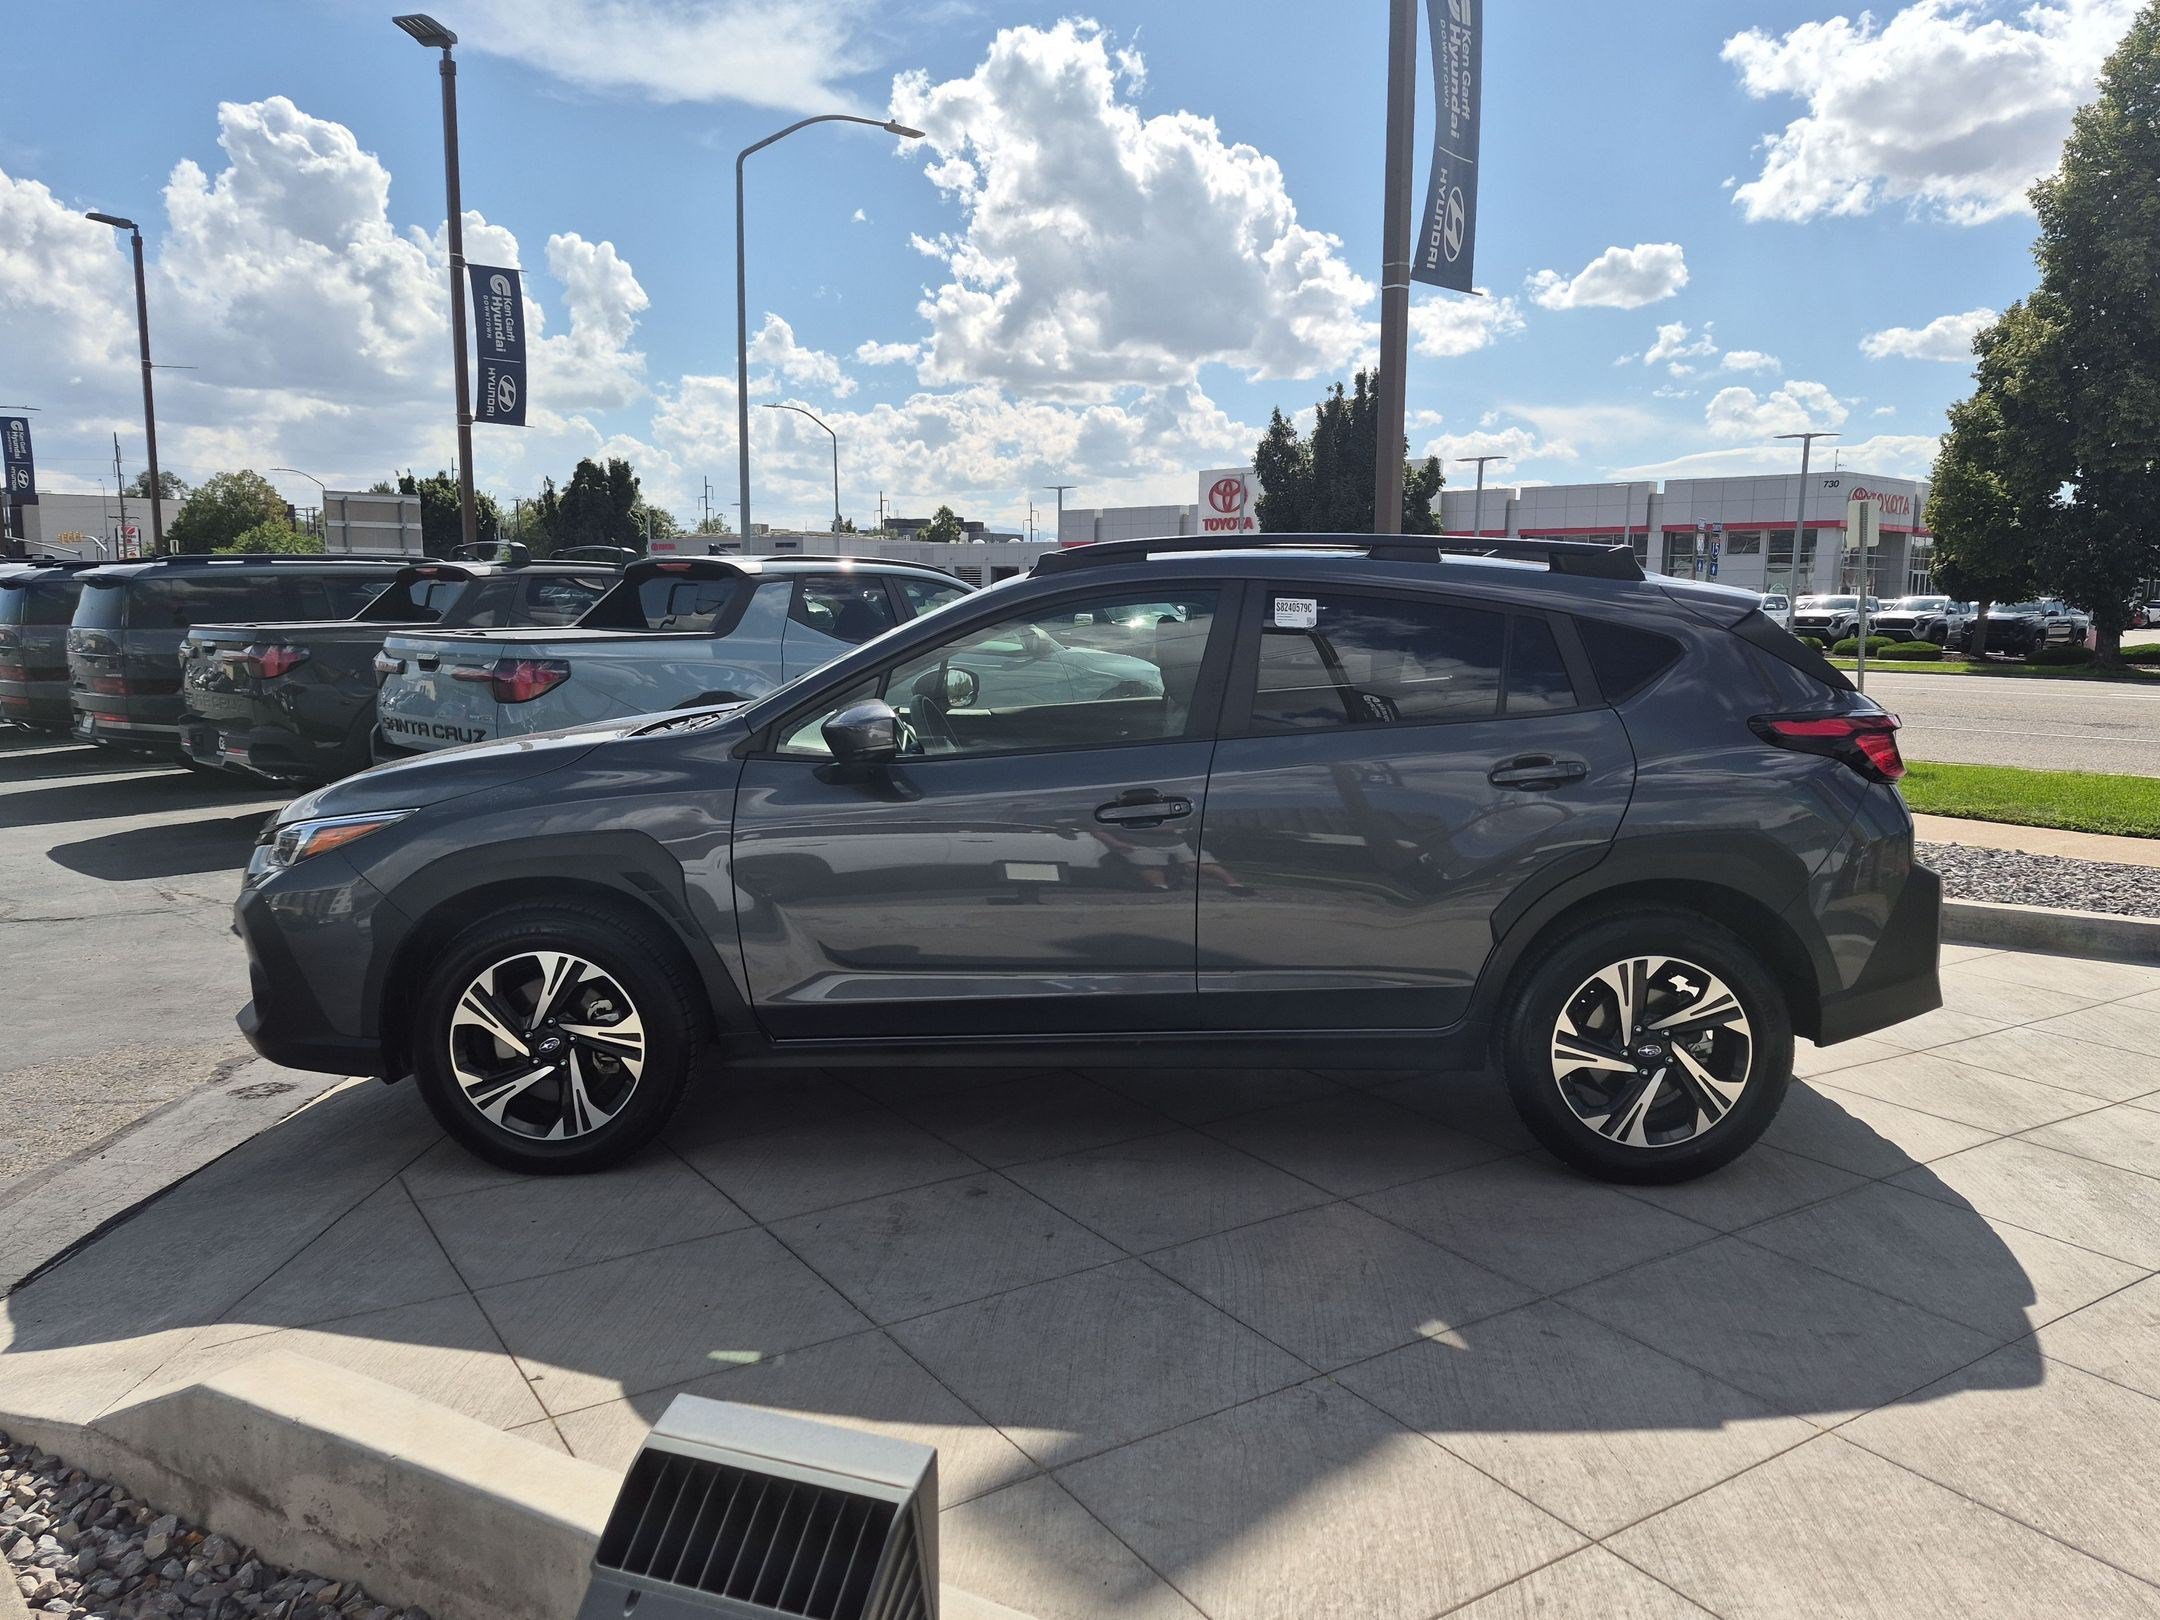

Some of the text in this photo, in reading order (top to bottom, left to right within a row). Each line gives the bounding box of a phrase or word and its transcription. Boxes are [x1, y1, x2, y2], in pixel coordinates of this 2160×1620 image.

[1440, 19, 1449, 108] DOWNTOWN
[1448, 23, 1461, 139] Hyundai
[1461, 28, 1471, 120] Ken Garff
[1426, 167, 1448, 269] HYUNDAI
[483, 294, 492, 339] DOWNTOWN
[491, 296, 506, 353] Hyundai
[503, 295, 516, 342] Ken Garff
[486, 367, 496, 417] HYUNDAI
[1823, 480, 1840, 488] 730
[1202, 516, 1254, 531] TOYOTA
[1712, 543, 1720, 555] 15
[1276, 602, 1312, 613] S8240579C
[383, 717, 487, 743] SANTA CRUZ
